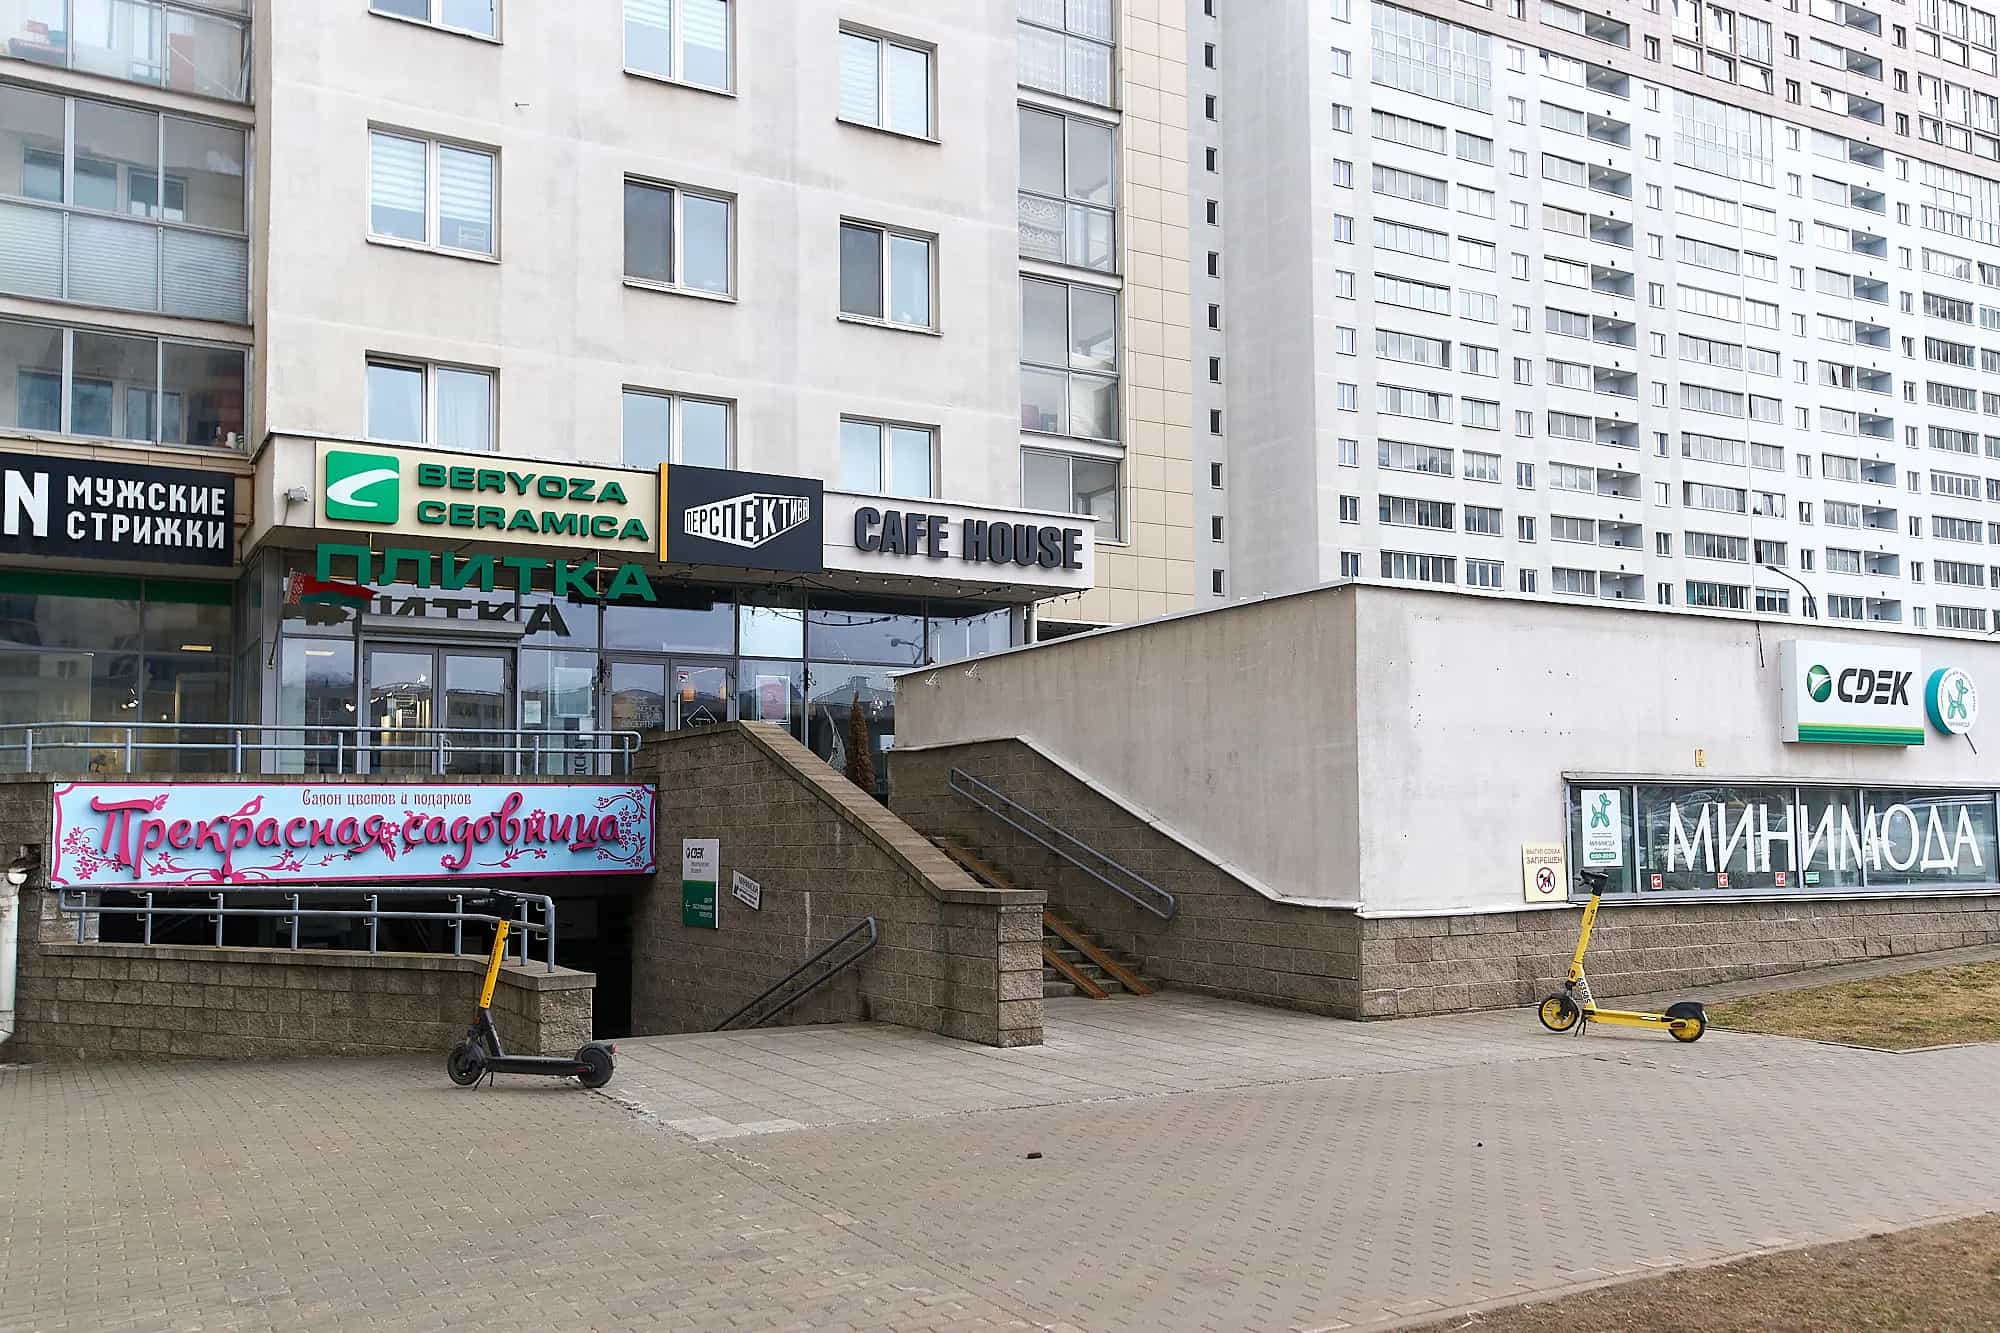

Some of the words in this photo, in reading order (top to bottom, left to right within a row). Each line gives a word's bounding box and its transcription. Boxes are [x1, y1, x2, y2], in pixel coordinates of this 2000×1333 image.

[67, 475, 226, 516] МУЖСКИЕ
[418, 463, 628, 504] BERYOZA
[66, 511, 225, 549] СТРИЖКИ
[416, 500, 650, 541] CERAMICA
[685, 497, 809, 542] ПЕРСПЕКТИВА
[854, 506, 949, 559] CAFE
[963, 518, 1083, 570] HOUSE
[314, 543, 656, 601] ПЛИТКА
[1837, 668, 1913, 706] CDEK
[302, 789, 341, 807] Салон
[347, 793, 396, 807] цветов
[401, 793, 408, 805] и
[414, 793, 472, 809] подарков
[91, 794, 393, 879] Прекрасная
[1666, 802, 1983, 873] МИНИМОДА
